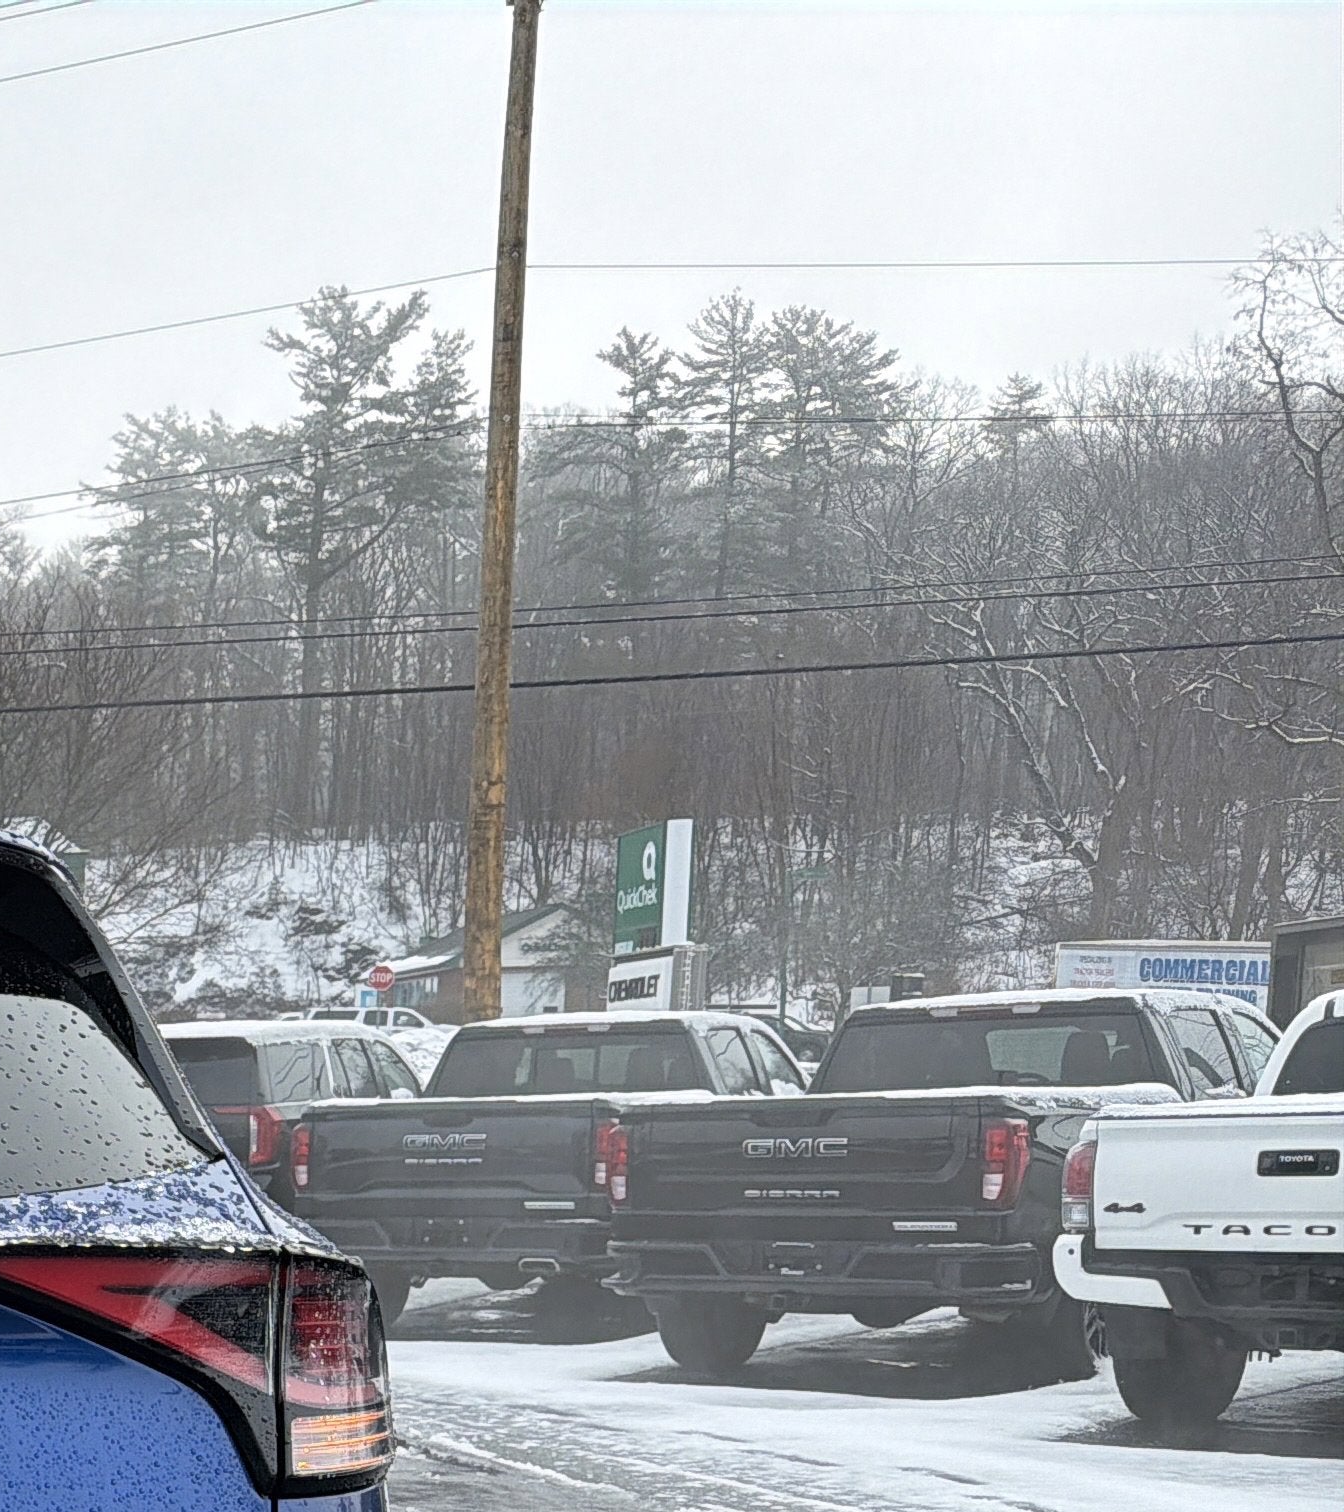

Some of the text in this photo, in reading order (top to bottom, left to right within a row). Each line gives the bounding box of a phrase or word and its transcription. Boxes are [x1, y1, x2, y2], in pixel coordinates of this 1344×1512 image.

[617, 883, 658, 914] QuickChek
[371, 972, 392, 983] STOP
[1139, 957, 1269, 985] COMMERCIAL
[403, 1133, 487, 1150] GMC
[742, 1137, 849, 1158] GMC
[1279, 1155, 1315, 1163] TOYOTA
